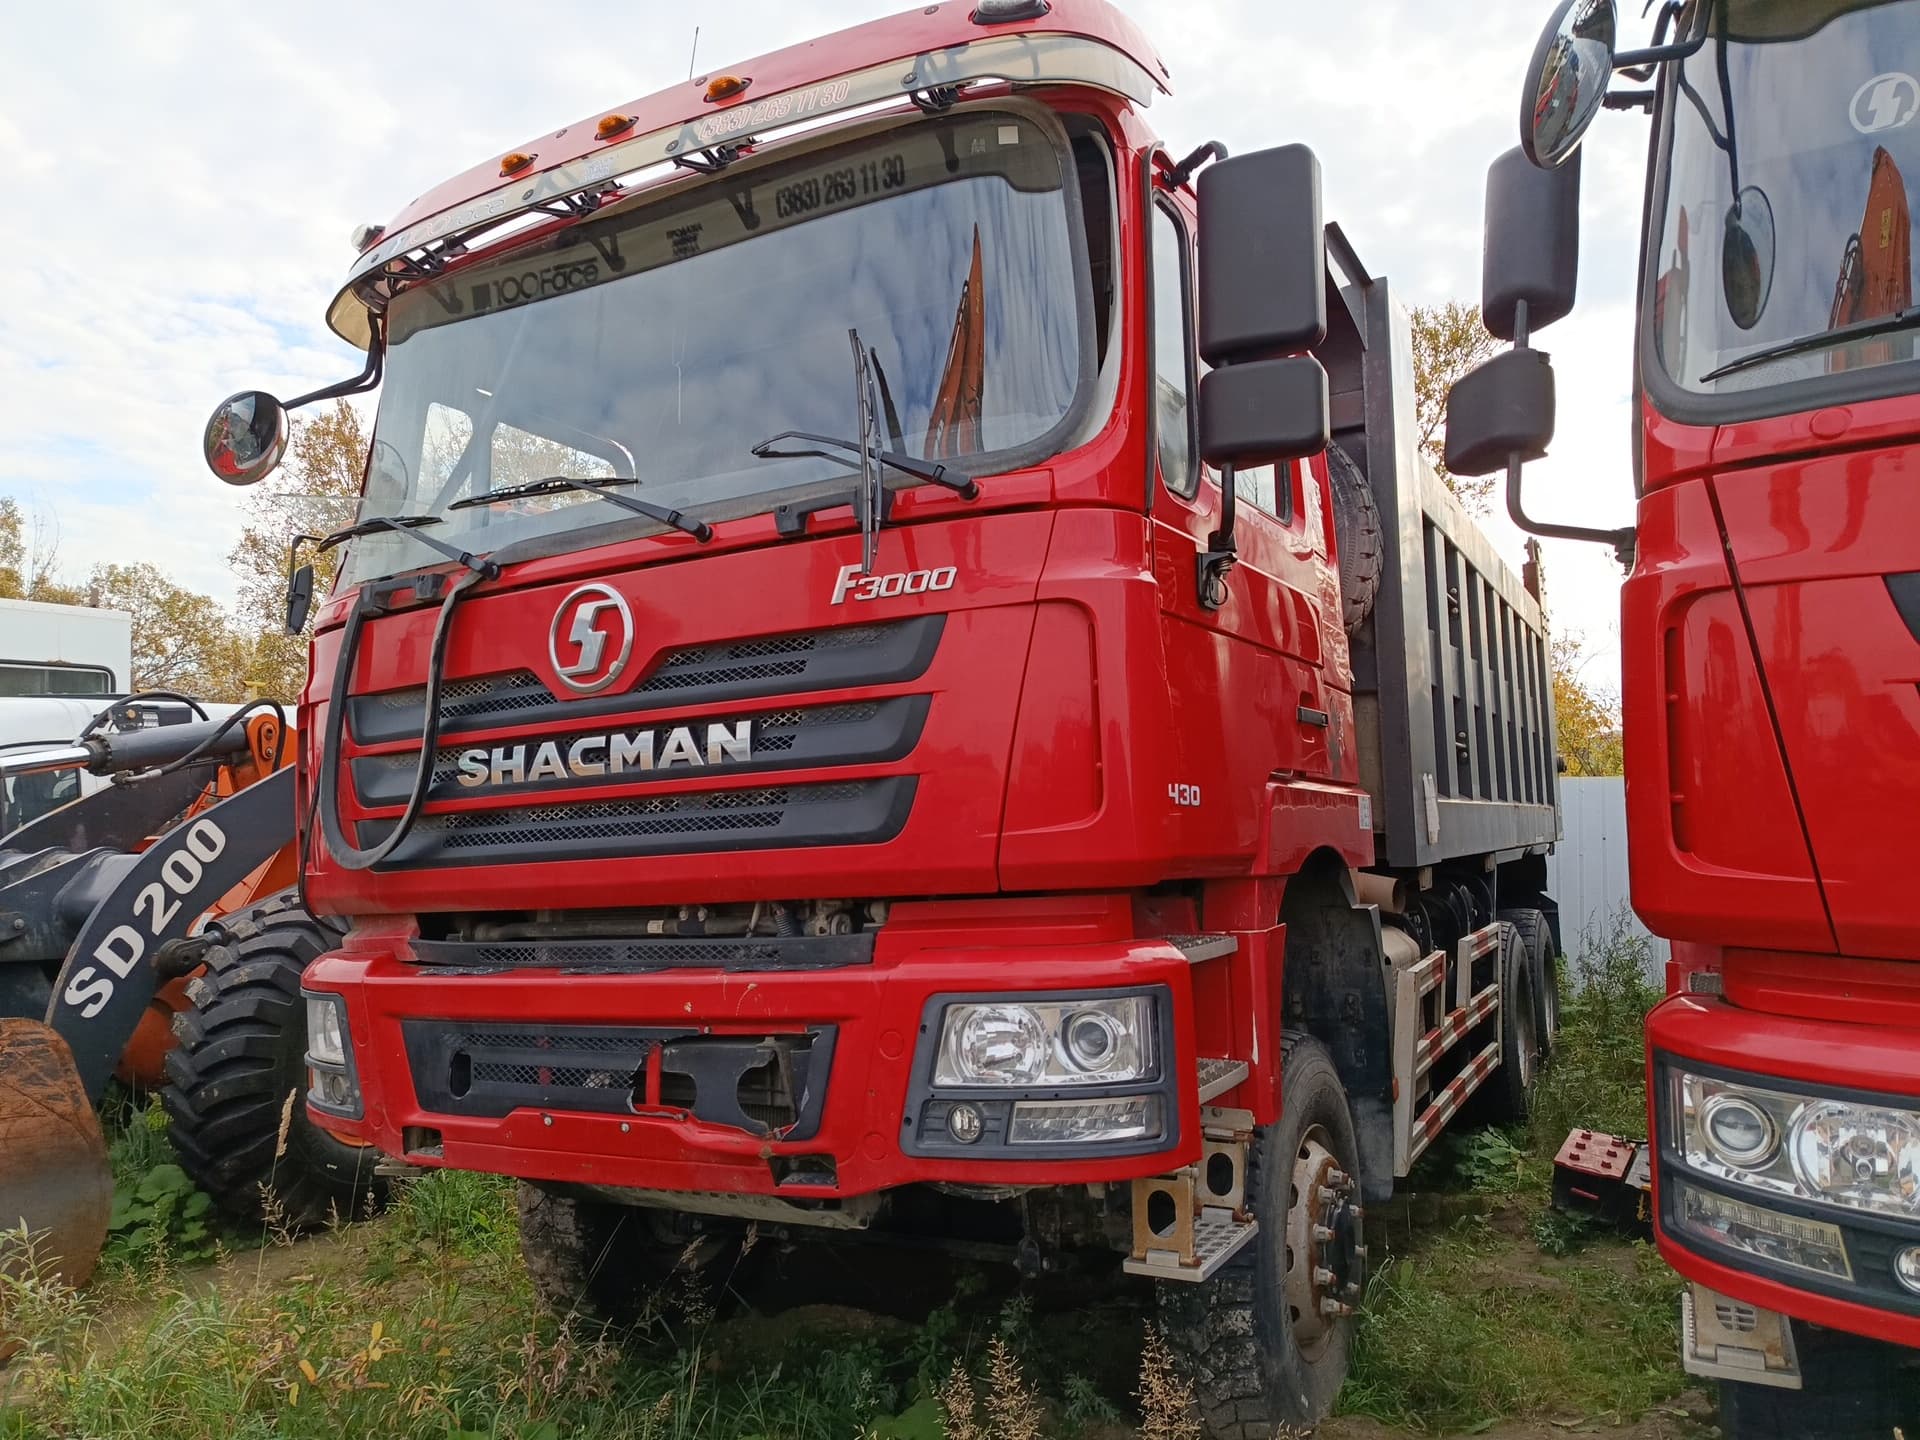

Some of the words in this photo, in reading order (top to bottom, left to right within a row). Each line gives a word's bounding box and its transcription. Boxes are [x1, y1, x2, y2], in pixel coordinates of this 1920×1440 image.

[750, 95, 792, 126] 263
[796, 87, 820, 113] 11
[820, 79, 850, 107] 30
[823, 167, 857, 205] 263
[859, 160, 879, 194] 11
[882, 154, 906, 189] 30
[830, 563, 957, 605] F3000
[456, 720, 752, 787] SHACMAN
[1168, 783, 1201, 806] 430
